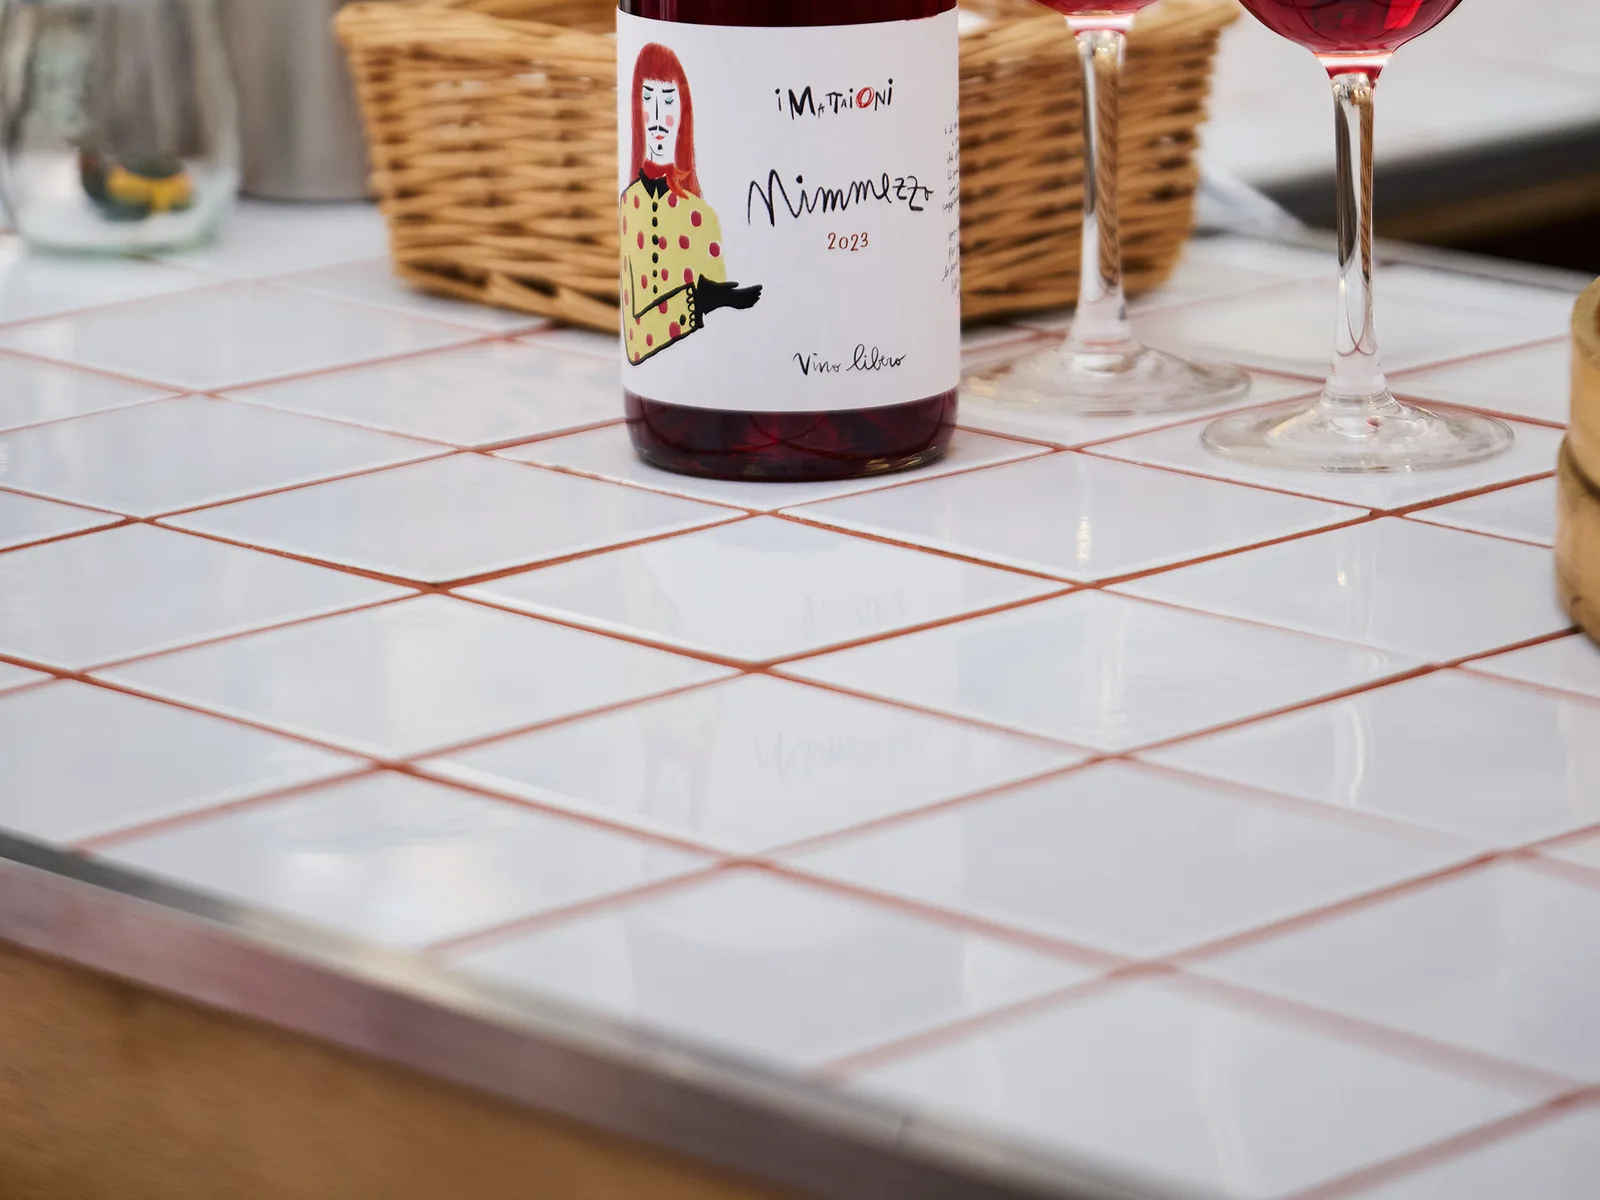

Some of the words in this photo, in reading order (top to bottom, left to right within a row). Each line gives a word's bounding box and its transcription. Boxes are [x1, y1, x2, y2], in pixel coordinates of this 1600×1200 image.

[827, 232, 869, 251] 2023
[793, 352, 841, 375] Vino
[846, 343, 907, 371] libero
